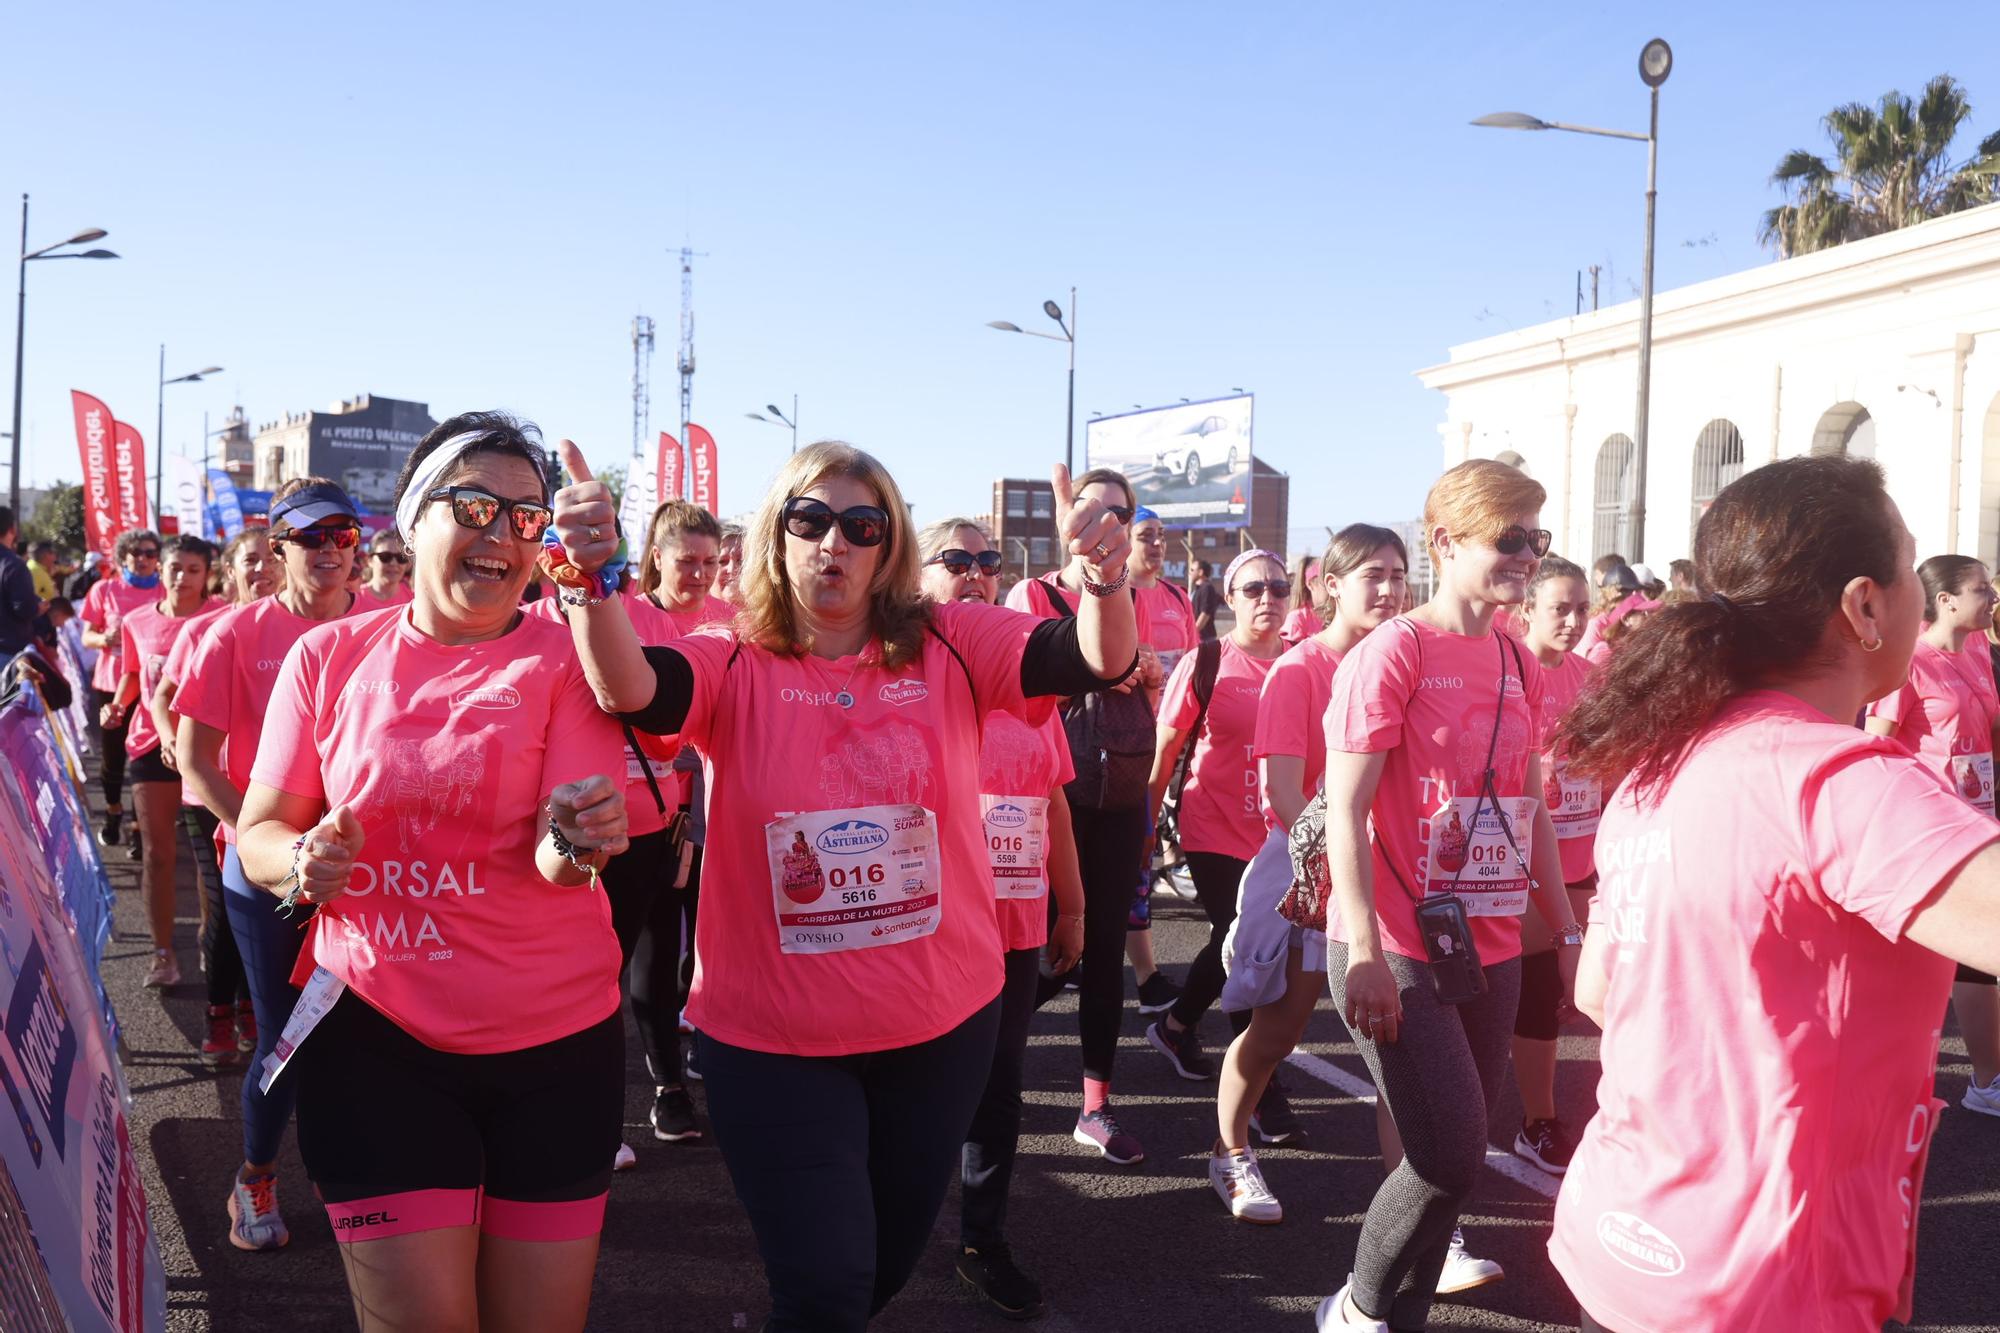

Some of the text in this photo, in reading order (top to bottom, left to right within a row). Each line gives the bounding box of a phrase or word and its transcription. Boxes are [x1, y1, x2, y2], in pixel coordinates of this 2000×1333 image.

[334, 426, 373, 441] PUERTO
[1419, 777, 1457, 805] TU
[1564, 790, 1587, 803] 016
[989, 812, 1025, 823] ASTURIANA
[894, 820, 925, 831] SUMA
[822, 833, 885, 849] ASTURIANA
[991, 836, 1023, 851] 016
[996, 854, 1017, 864] 5598
[1472, 845, 1506, 862] 016
[829, 863, 885, 888] 016
[1478, 866, 1501, 877] 4044
[842, 889, 877, 904] 5616
[797, 900, 927, 924] CARRERA DE LA MUJER 2023
[884, 915, 931, 935] Santander
[795, 932, 844, 945] OYSHO
[384, 950, 453, 963] MUJER 2023
[1600, 1220, 1677, 1271] ASTURIANA
